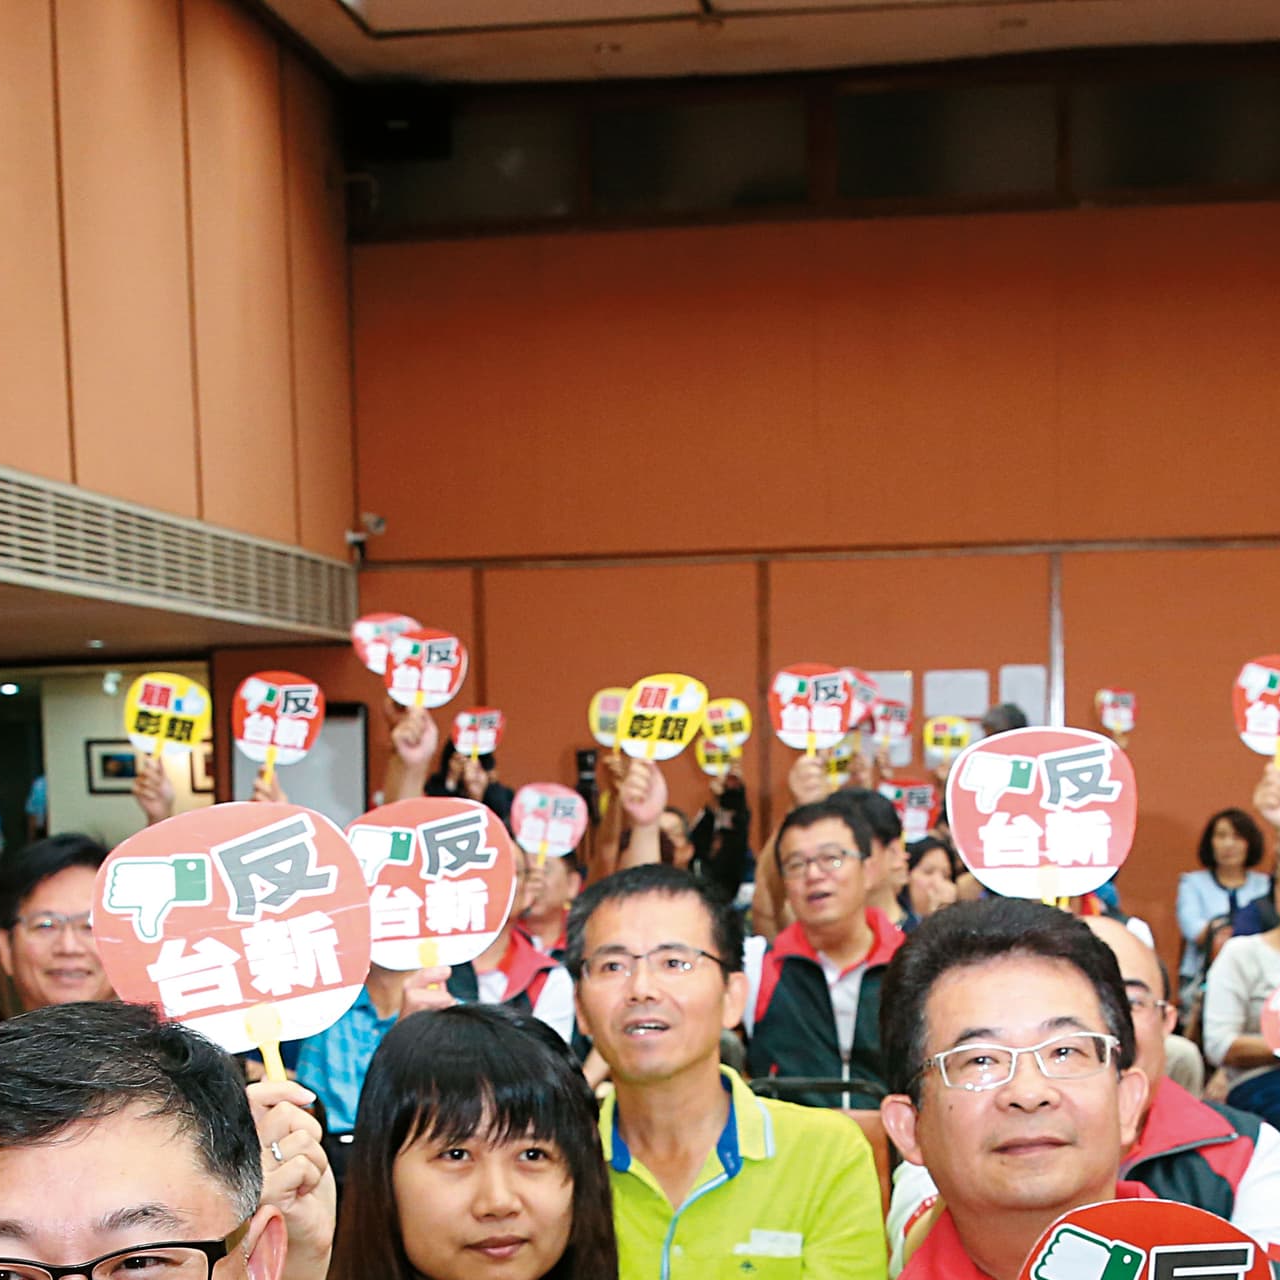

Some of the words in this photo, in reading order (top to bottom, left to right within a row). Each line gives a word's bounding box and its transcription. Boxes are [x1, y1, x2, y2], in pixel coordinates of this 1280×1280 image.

[281, 686, 317, 716] 反
[1045, 747, 1117, 806] 反
[217, 818, 333, 918] 反
[422, 814, 494, 876] 反
[978, 809, 1113, 868] 台新
[369, 877, 489, 939] 台新
[146, 911, 343, 1017] 台新
